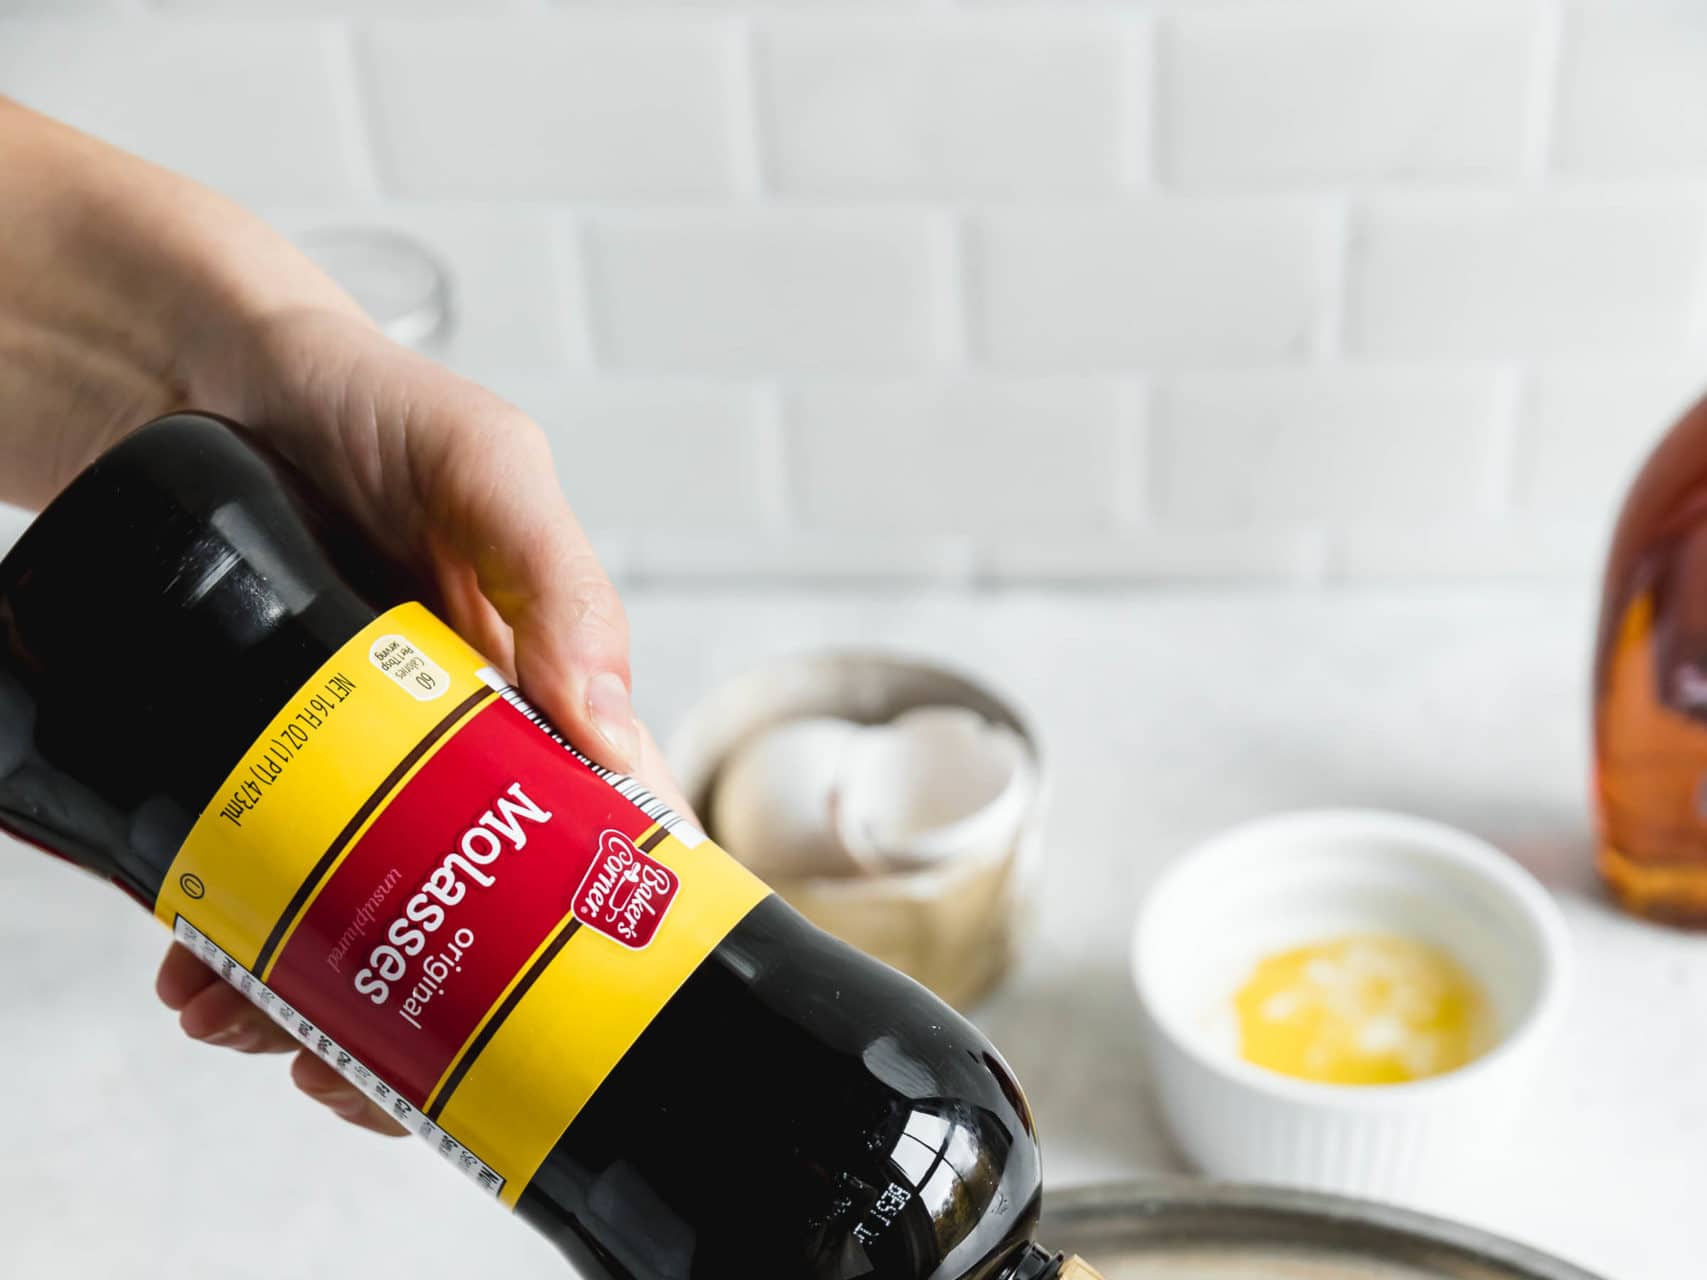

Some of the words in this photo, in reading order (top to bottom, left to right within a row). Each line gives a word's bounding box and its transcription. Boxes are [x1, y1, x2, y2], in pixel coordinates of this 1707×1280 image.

[374, 641, 399, 661] serving
[381, 656, 401, 671] Tbsp
[395, 656, 424, 679] Calories
[416, 672, 435, 690] 60
[324, 672, 357, 703] NET
[295, 707, 323, 729] FL
[310, 694, 335, 717] 16
[269, 738, 294, 763] (1
[281, 723, 309, 750] OZ
[249, 755, 283, 785] PT)
[219, 780, 263, 827] 473mL
[585, 837, 633, 918] Corner
[354, 782, 552, 1004] Molasses
[617, 864, 671, 939] Baker's
[327, 868, 403, 973] unsulphured
[400, 928, 474, 1030] original
[870, 1182, 911, 1226] BEST
